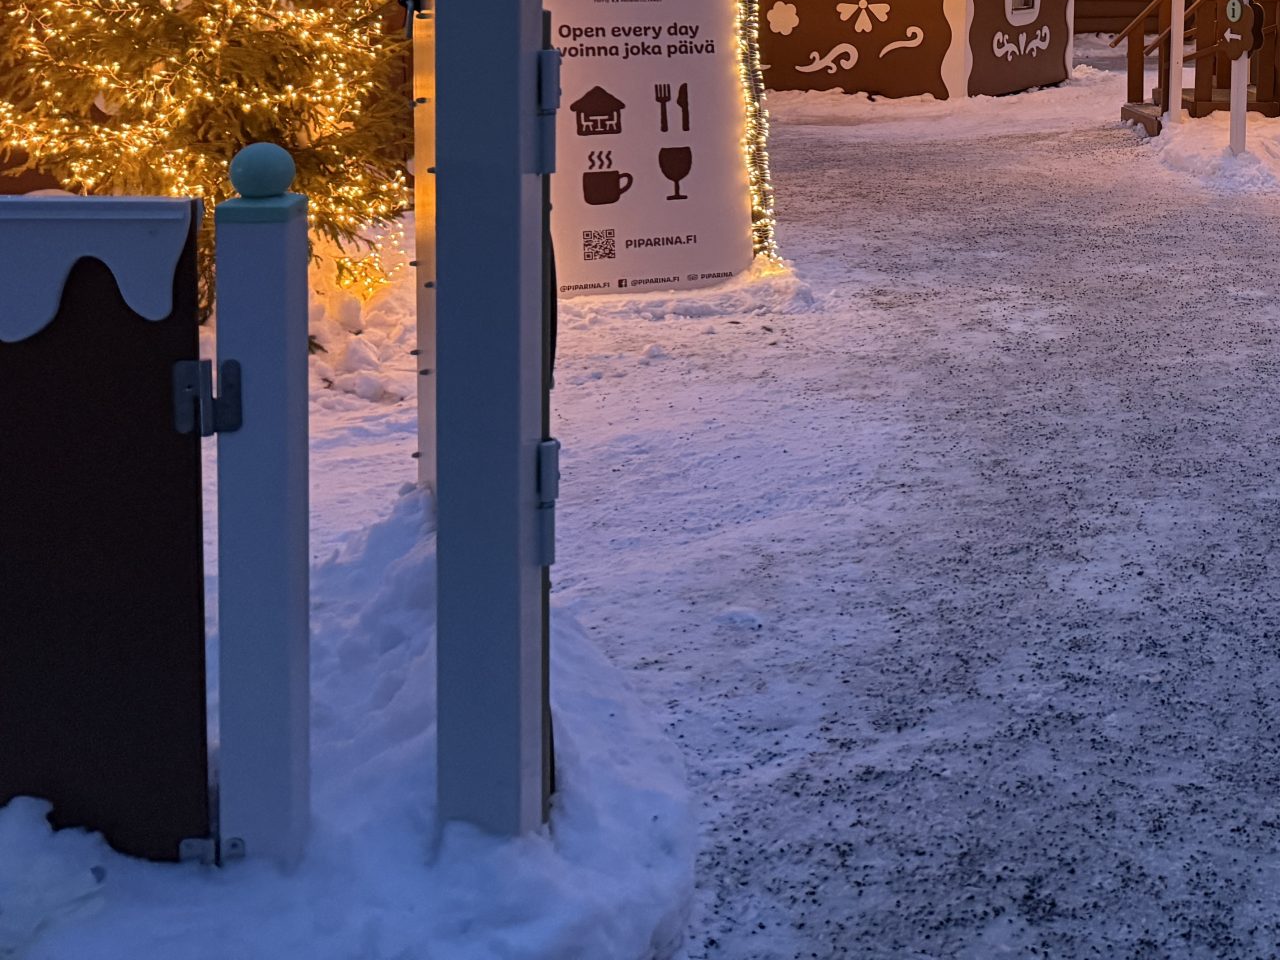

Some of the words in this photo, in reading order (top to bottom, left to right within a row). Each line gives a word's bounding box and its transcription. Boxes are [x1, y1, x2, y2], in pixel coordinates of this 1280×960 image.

[558, 24, 606, 41] Open
[611, 24, 662, 40] every
[667, 22, 700, 39] day
[622, 42, 662, 60] joka
[667, 40, 715, 58] päivä
[625, 234, 697, 249] PIPARINA.FI
[560, 282, 610, 292] @PIPARINA.FI
[631, 275, 680, 287] @PIPARINA.FI
[700, 271, 733, 280] PIPARINA
